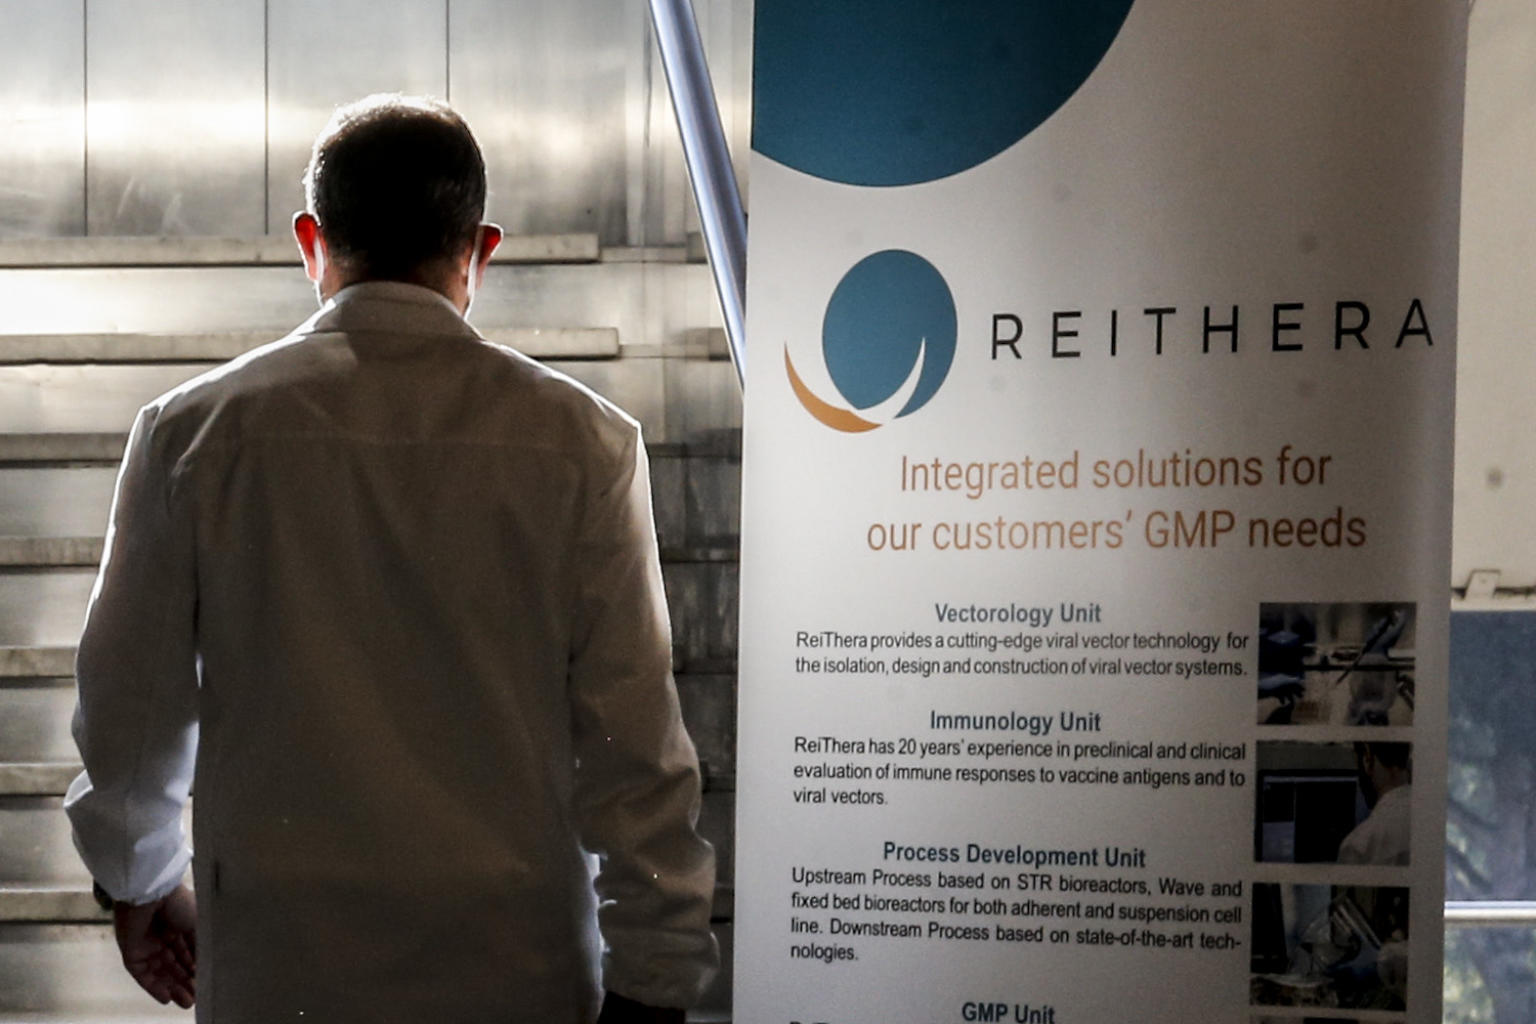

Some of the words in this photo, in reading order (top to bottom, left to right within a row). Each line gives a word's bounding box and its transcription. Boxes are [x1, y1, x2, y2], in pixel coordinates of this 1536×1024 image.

[992, 298, 1434, 360] REITHERA
[902, 451, 1078, 499] Integrated
[1093, 449, 1263, 488] solutions
[1276, 444, 1332, 486] for
[868, 523, 922, 551] our
[1145, 510, 1235, 548] GMP
[1249, 506, 1367, 548] needs
[935, 604, 1053, 627] Vectorology
[1061, 603, 1101, 622] Unit
[797, 632, 867, 648] ReiThera
[871, 633, 932, 651] provides
[935, 636, 944, 648] a
[947, 633, 1042, 652] cutting-edge
[1047, 633, 1078, 648] viral
[1082, 633, 1130, 648] vector
[1133, 632, 1220, 653] technology
[1227, 632, 1249, 649] for
[796, 657, 820, 672] the
[824, 657, 888, 676] isolation,
[892, 658, 940, 678] design
[943, 658, 970, 673] and
[974, 659, 1068, 674] construction
[1071, 658, 1086, 674] of
[1089, 659, 1121, 674] viral
[1125, 660, 1172, 675] vector
[1176, 660, 1247, 679] systems.
[931, 710, 1053, 736] Immunology
[1060, 712, 1100, 732] Unit
[795, 736, 865, 754] ReiThera
[869, 738, 895, 754] has
[898, 738, 916, 754] 20
[967, 740, 1052, 759] experience
[1057, 741, 1070, 757] in
[1074, 741, 1153, 761] preclinical
[1156, 742, 1186, 759] and
[1190, 742, 1246, 760] clinical
[794, 763, 872, 779] evaluation
[876, 763, 890, 779] of
[893, 764, 952, 781] immune
[956, 768, 1036, 785] responses
[1040, 767, 1055, 783] to
[1059, 768, 1118, 784] vaccine
[1123, 769, 1191, 789] antigens
[1194, 769, 1225, 786] and
[1230, 770, 1245, 787] to
[793, 788, 826, 803] viral
[831, 789, 887, 805] vectors.
[884, 841, 960, 862] Process
[967, 843, 1098, 870] Development
[1105, 847, 1146, 868] Unit
[792, 867, 866, 887] Upstream
[873, 869, 931, 887] Process
[938, 872, 984, 889] based
[991, 877, 1010, 889] on
[1018, 873, 1052, 890] STR
[1059, 875, 1151, 896] bioreactors,
[1159, 877, 1204, 896] Wave
[1211, 880, 1242, 897] and
[791, 891, 828, 909] fixed
[833, 894, 860, 910] bed
[864, 894, 945, 913] bioreactors
[950, 897, 969, 914] for
[974, 898, 1007, 915] both
[1011, 899, 1080, 918] adherent
[1085, 902, 1114, 919] and
[1119, 905, 1209, 924] suspension
[1214, 907, 1241, 923] cell
[791, 917, 822, 934] line.
[830, 918, 922, 937] Downstream
[928, 921, 989, 941] Process
[996, 925, 1044, 943] based
[1050, 930, 1070, 943] on
[1076, 929, 1194, 949] state-of-the-art
[1200, 933, 1241, 950] tech-
[791, 943, 858, 964] nologies.
[962, 1001, 1008, 1022] GMP
